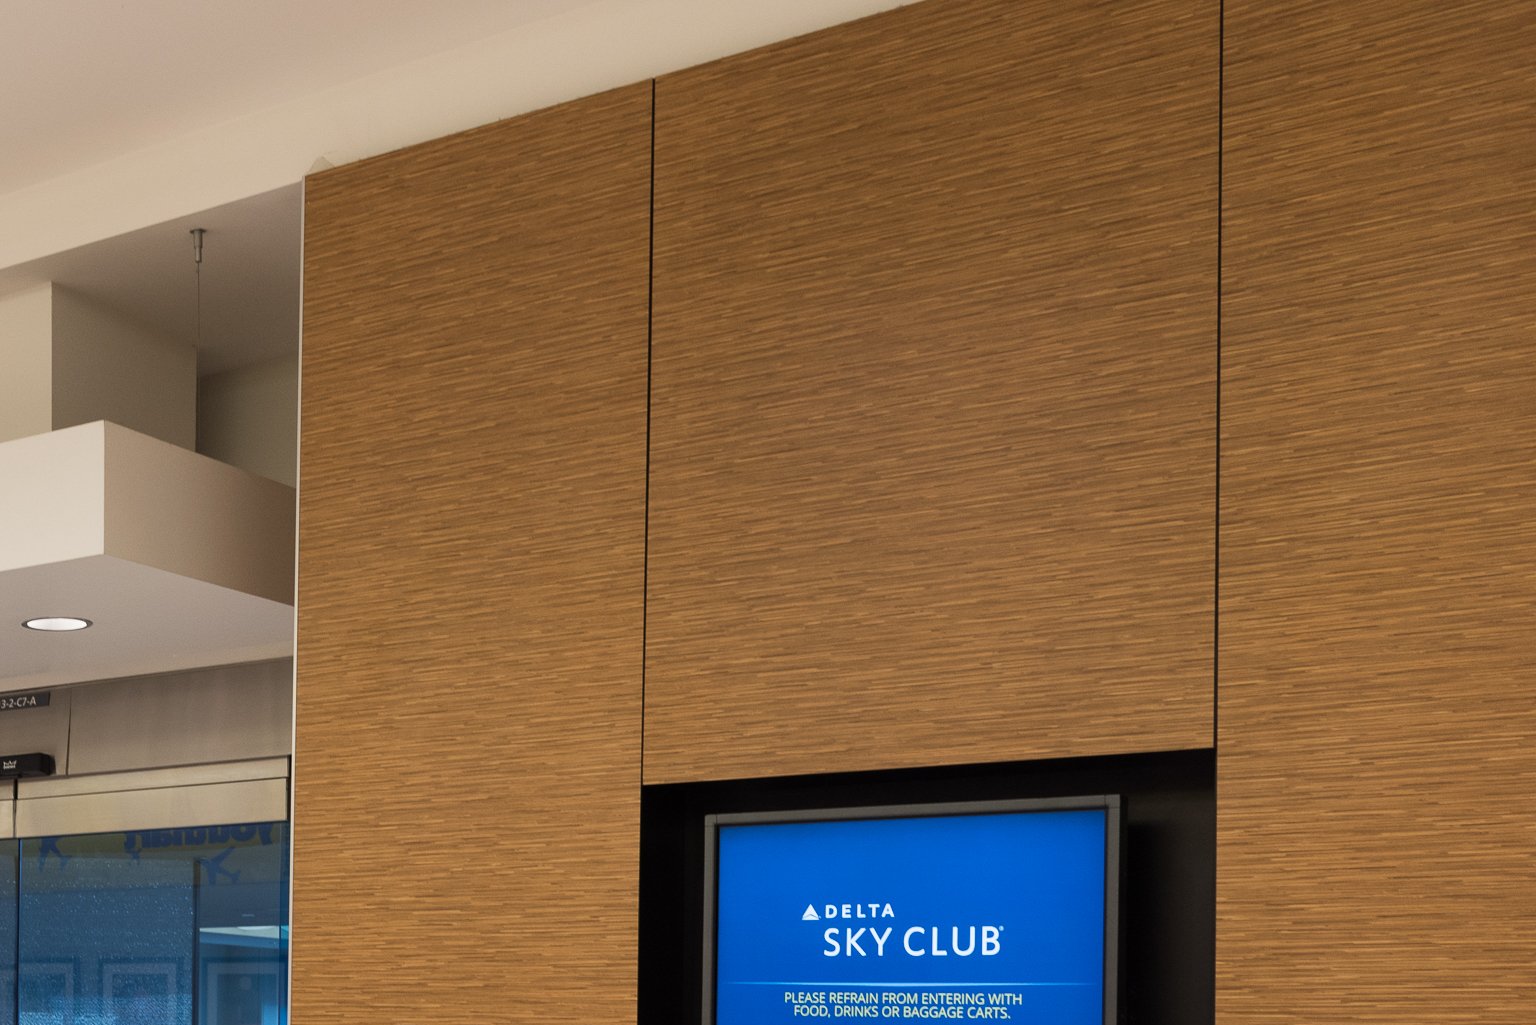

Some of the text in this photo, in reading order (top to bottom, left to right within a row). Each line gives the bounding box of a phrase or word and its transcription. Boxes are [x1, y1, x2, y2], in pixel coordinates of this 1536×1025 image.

[825, 904, 894, 918] DELTA
[823, 928, 892, 956] SKY
[785, 992, 1022, 1005] PLEASE REFRAIN FROM ENTERING WITH
[794, 1005, 1010, 1019] FOOD, DRINKS OR BAGGAGE CARTS.
